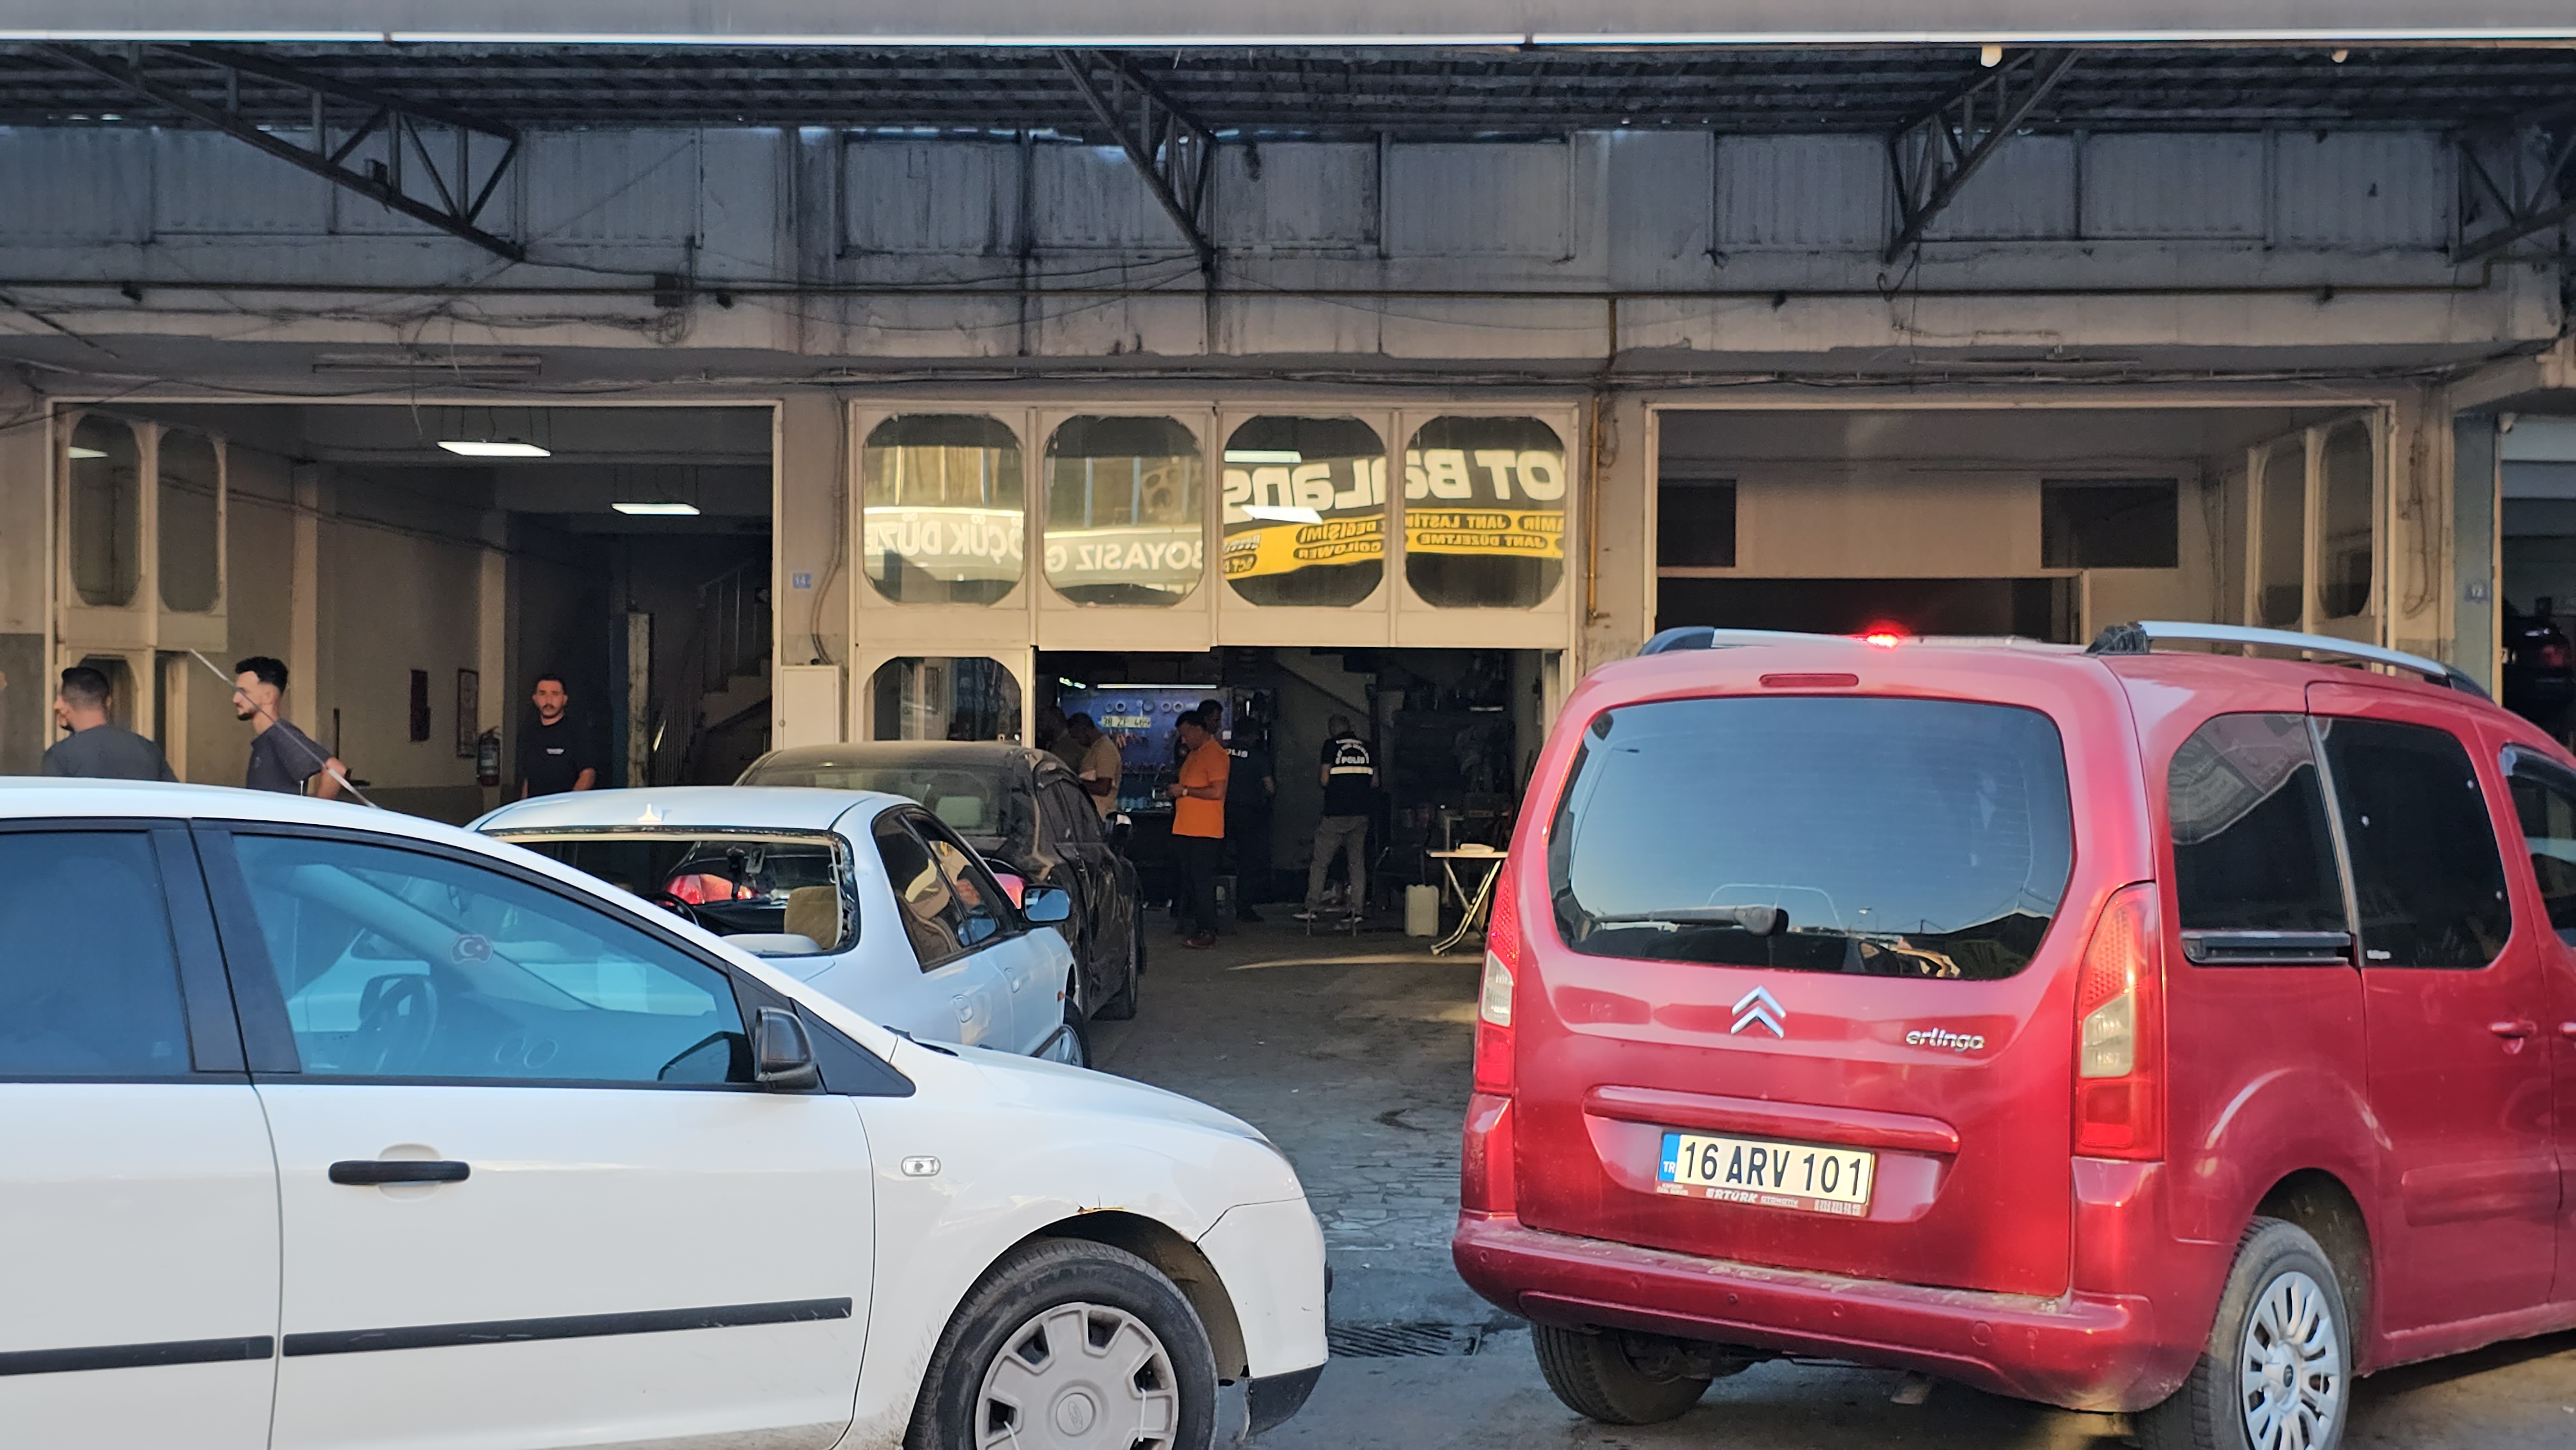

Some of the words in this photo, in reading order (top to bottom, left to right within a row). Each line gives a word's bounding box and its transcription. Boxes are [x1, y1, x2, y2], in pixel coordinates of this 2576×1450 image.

[1663, 1161, 1676, 1174] TR
[1685, 1142, 1718, 1180] 16
[1726, 1145, 1790, 1188] ARV
[1803, 1153, 1861, 1196] 101
